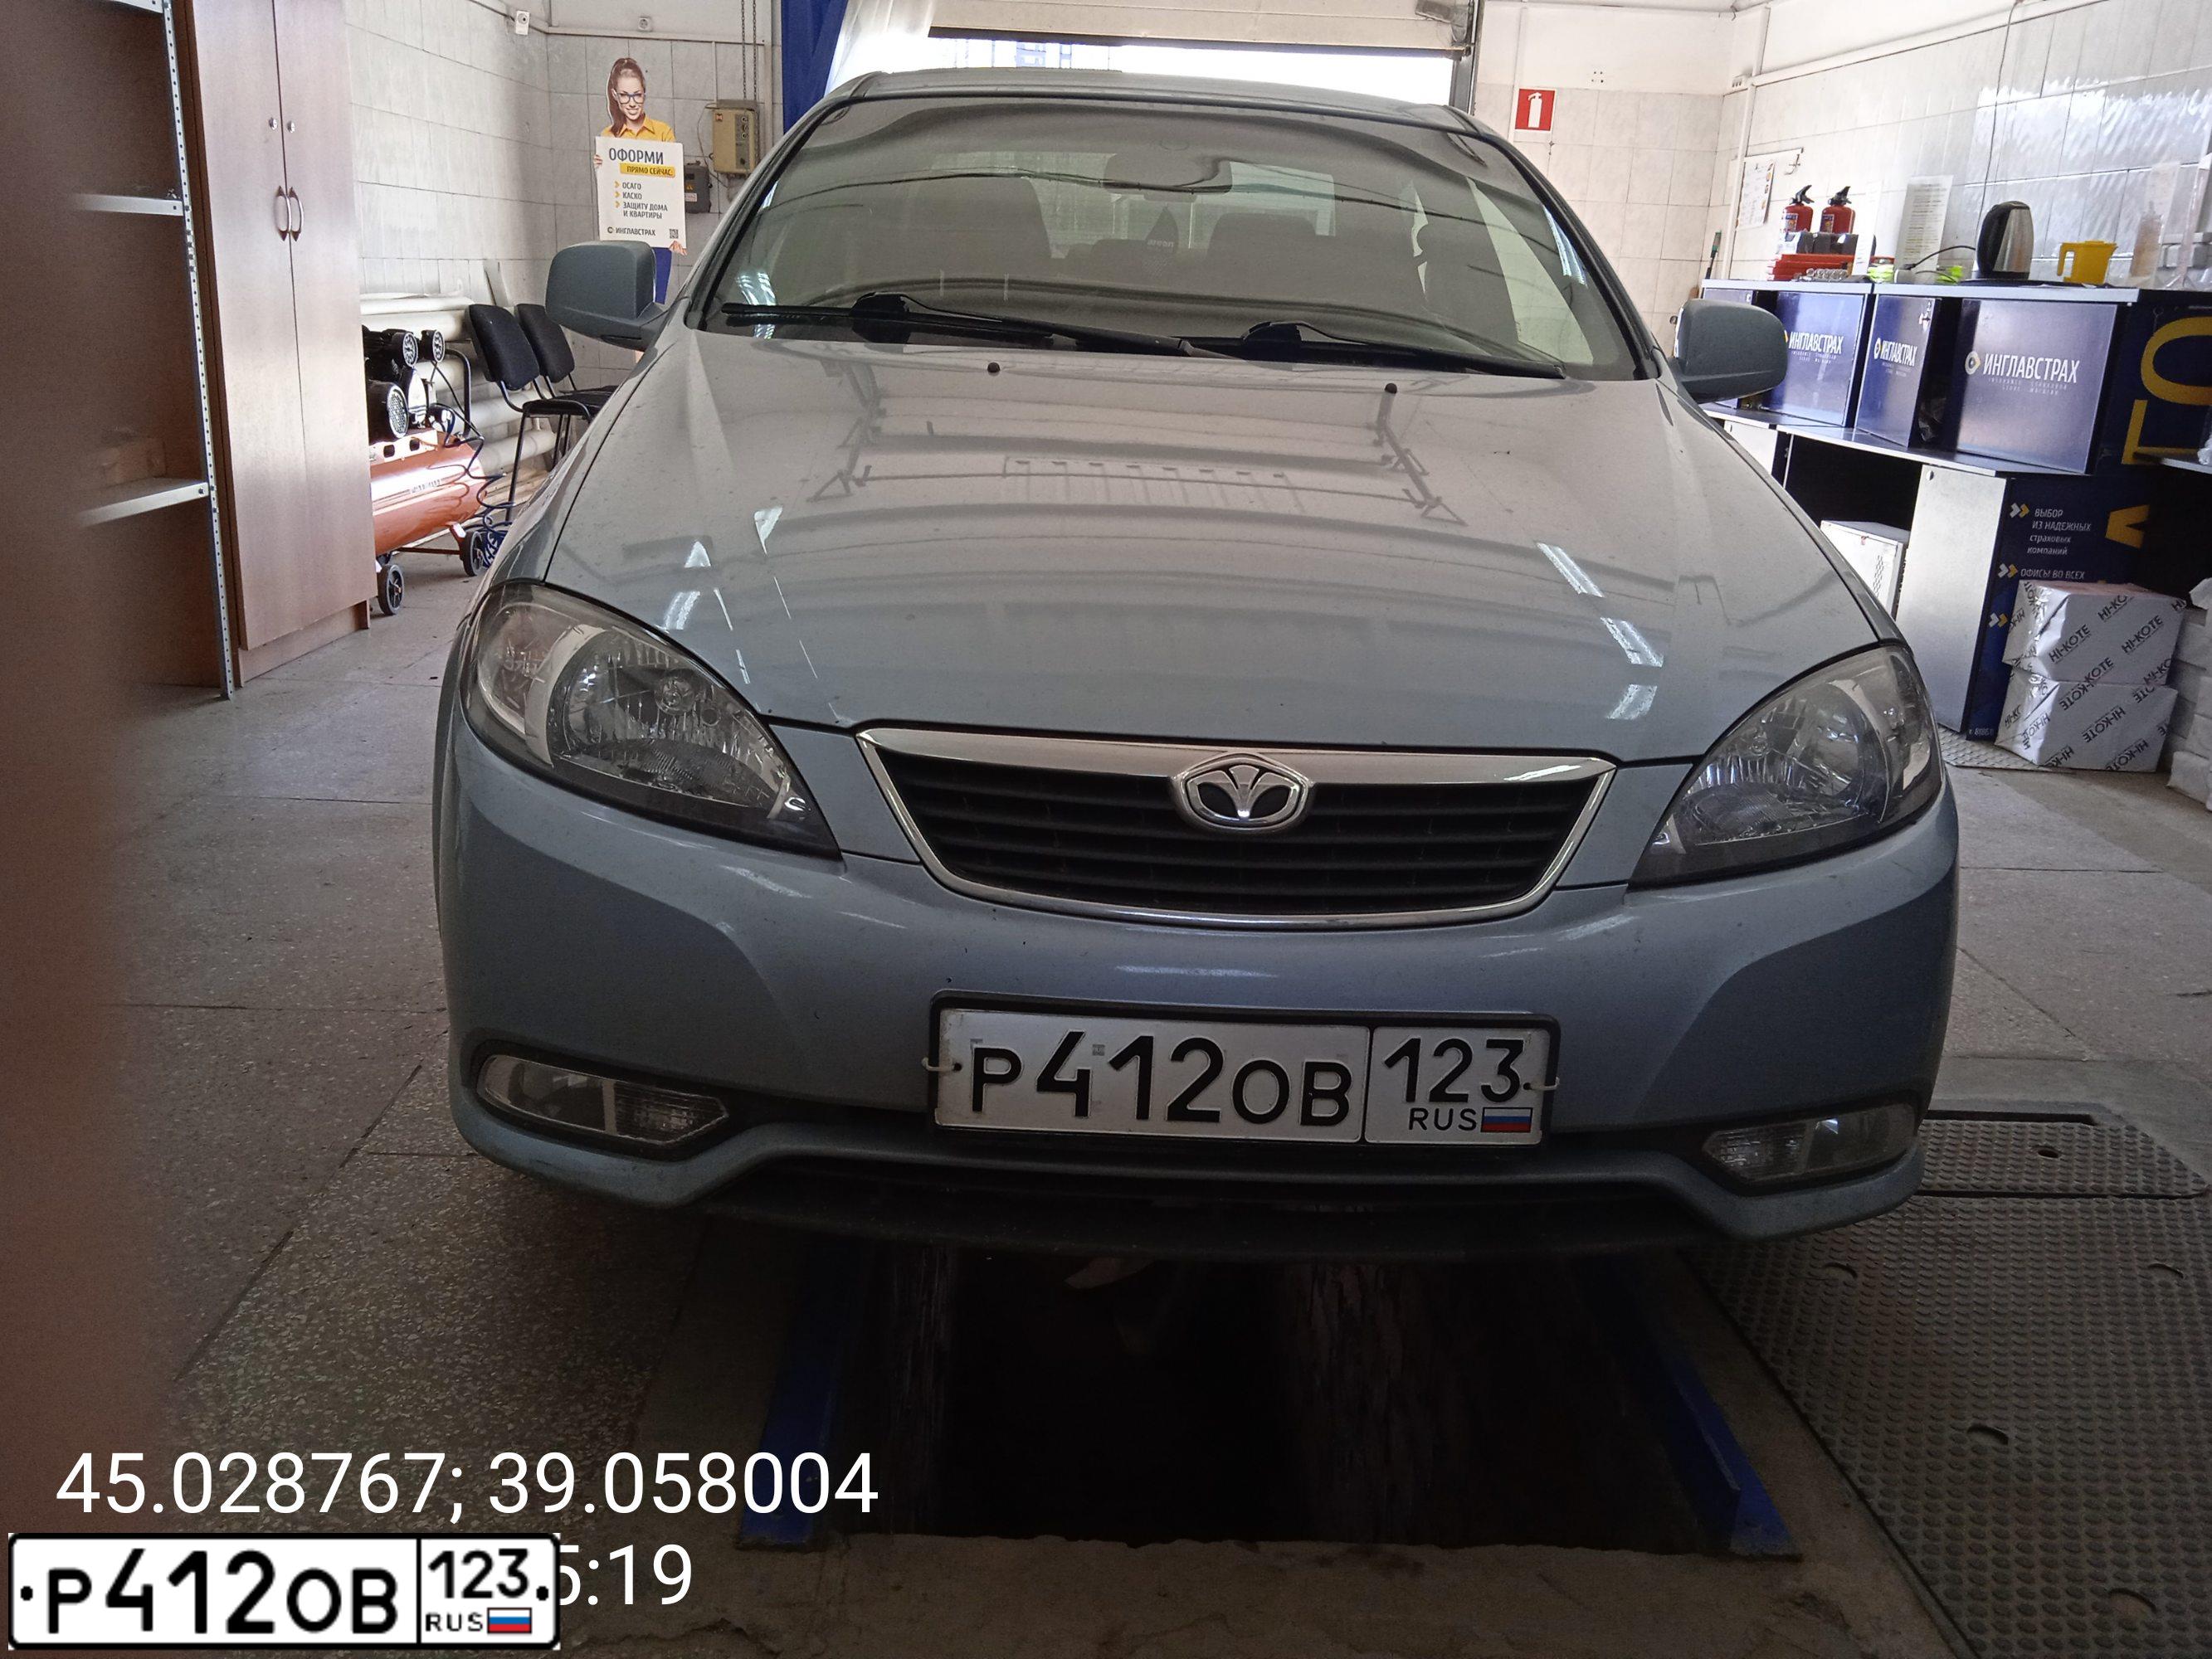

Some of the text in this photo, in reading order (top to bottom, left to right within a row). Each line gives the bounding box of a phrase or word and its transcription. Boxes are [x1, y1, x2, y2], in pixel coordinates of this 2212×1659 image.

[609, 148, 664, 165] ОФОРМИ
[626, 166, 648, 174] ПРЯМО
[622, 182, 641, 190] ОСАГО
[622, 192, 642, 200] КАСКО
[623, 202, 668, 212] ЗАЩИТУ ДОМА
[629, 211, 663, 219] КВАРТИРЫ
[616, 227, 656, 236] ИНГЛАВСТРАХ
[1788, 331, 1844, 354] ИНГЛАВСТРАХ
[1880, 340, 1918, 367] ИНГЛАВСТРАХ
[1983, 353, 2080, 383] ИНГЛАВСТРАХ
[2034, 508, 2063, 518] ВЫБОР
[2032, 521, 2042, 529] ИЗ
[2020, 569, 2050, 578] ОФИСЫ
[2065, 571, 2085, 580] ВСЕХ
[2121, 615, 2163, 654] HI-KOTE
[2049, 624, 2091, 662] HI-KOTE
[2082, 706, 2126, 742] HI-KOTE
[1384, 1038, 1525, 1104] 123
[1409, 1107, 1477, 1131] RUS
